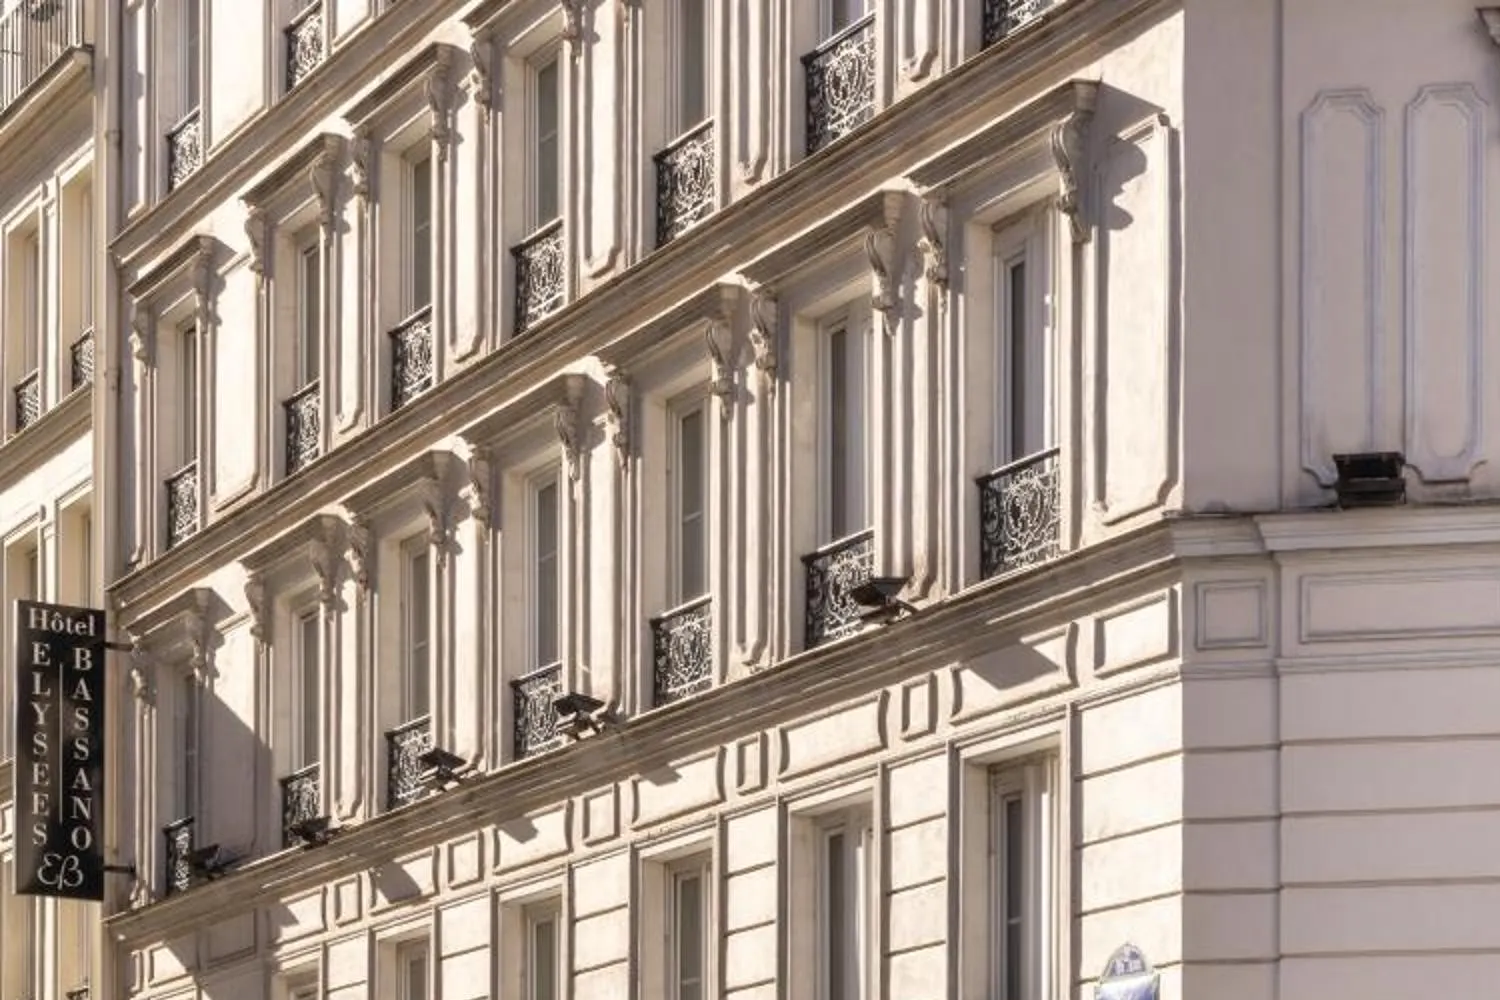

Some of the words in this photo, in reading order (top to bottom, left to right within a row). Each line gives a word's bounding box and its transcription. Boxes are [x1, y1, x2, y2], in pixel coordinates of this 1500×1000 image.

[28, 607, 96, 637] Hôtel
[31, 641, 51, 847] ELYSEES
[71, 647, 92, 850] BASSANO
